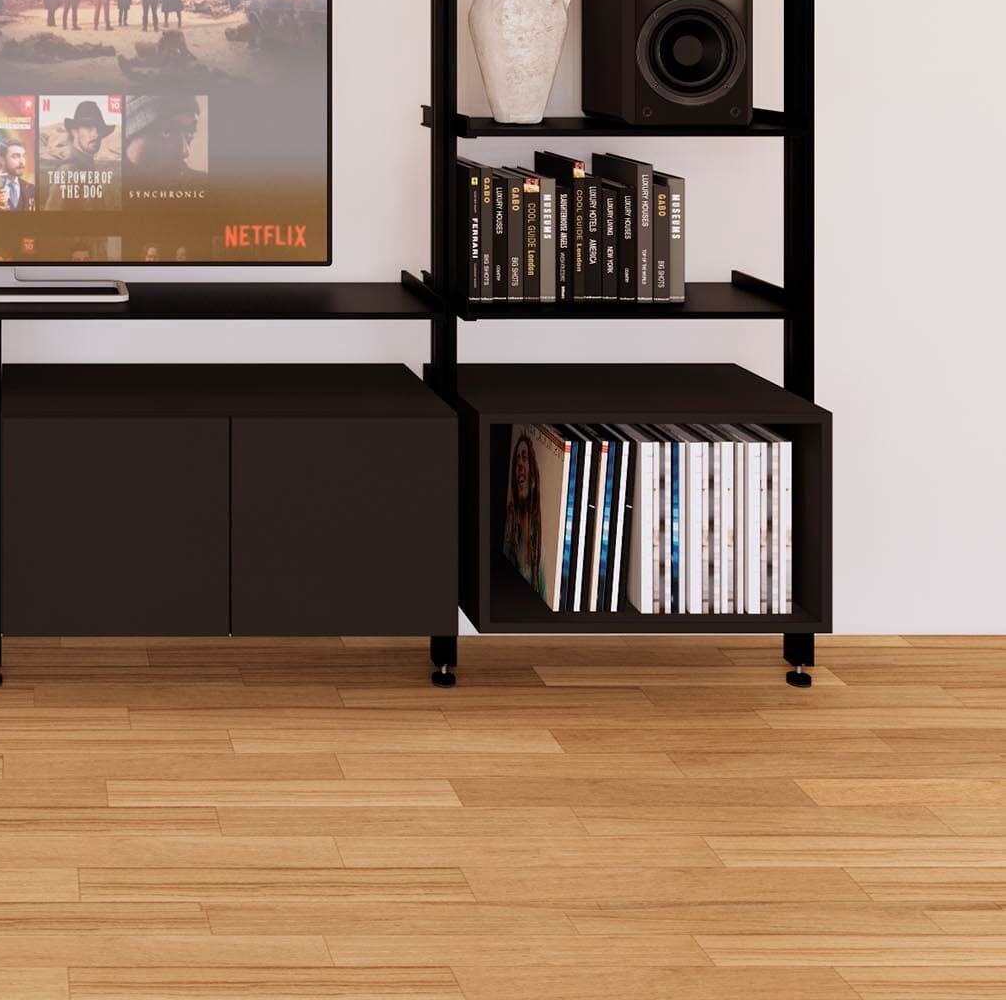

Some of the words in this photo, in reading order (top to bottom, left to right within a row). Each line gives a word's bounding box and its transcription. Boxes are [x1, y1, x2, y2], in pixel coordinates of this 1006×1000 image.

[48, 171, 66, 185] THE
[66, 171, 100, 185] POWER
[100, 171, 113, 185] OF
[641, 174, 650, 200] LUXURY
[60, 185, 80, 200] THE
[84, 185, 103, 200] DOG
[129, 190, 206, 200] SYNCHRONIC
[483, 177, 491, 204] GABO
[511, 187, 520, 212] GABO
[576, 190, 584, 213] COOL
[589, 186, 597, 209] LUXURY
[527, 202, 536, 224] COOL
[543, 194, 552, 240] MUSEUMS
[624, 196, 632, 217] LUXURY
[641, 200, 650, 227] HOUSES
[658, 194, 666, 217] GABO
[672, 194, 681, 240] MUSEUMS
[576, 215, 584, 240] GUIDE
[589, 210, 597, 232] HOTELS
[624, 218, 632, 240] HOUSES
[225, 225, 308, 248] NETFLIX
[527, 225, 536, 248] GUIDE
[527, 250, 536, 276] London
[576, 243, 584, 272] London
[606, 246, 614, 258] NEW
[511, 267, 519, 287] SHOTS
[606, 259, 614, 274] YORK
[658, 270, 666, 288] SHOTS
